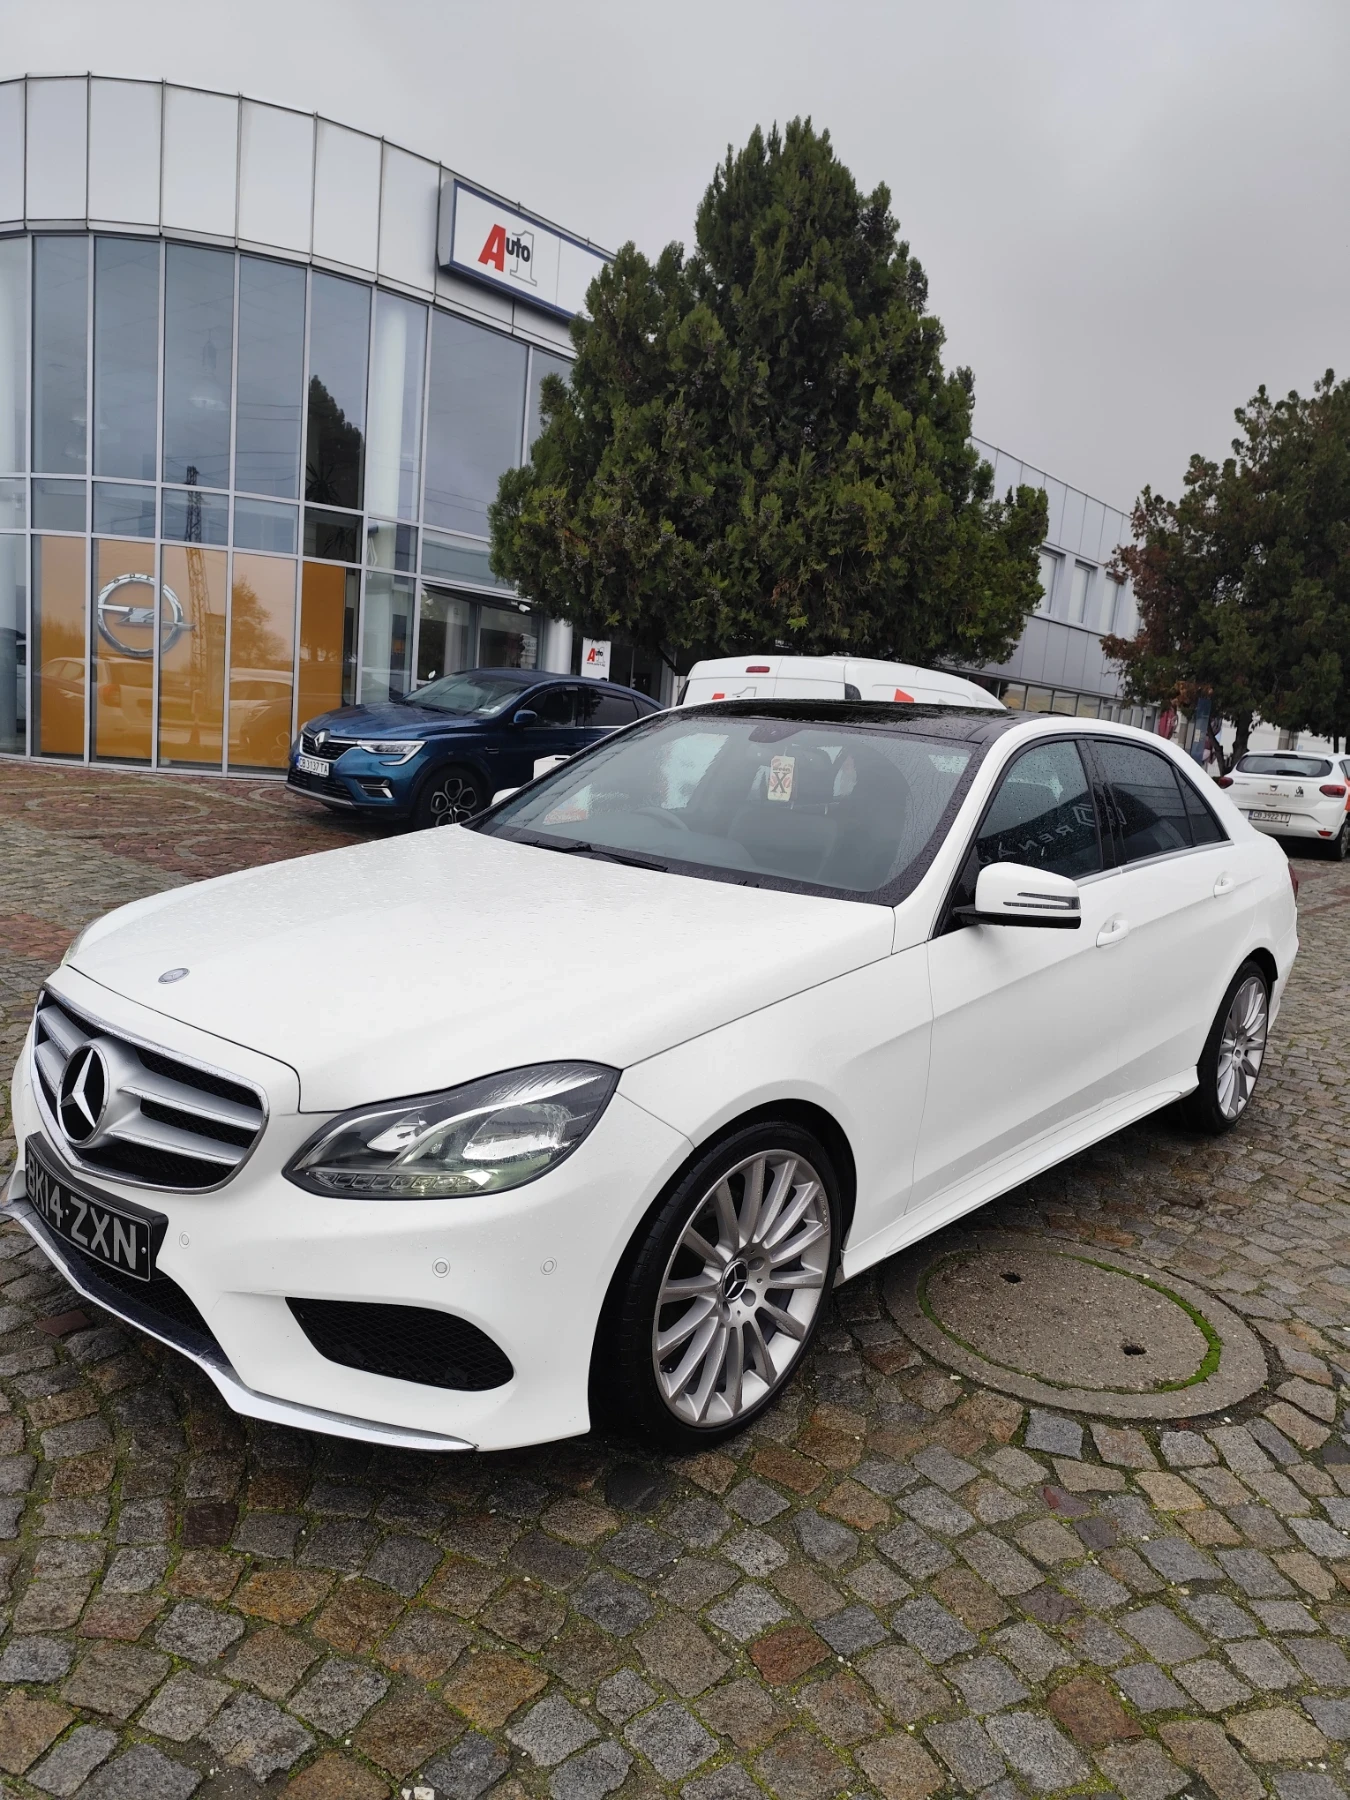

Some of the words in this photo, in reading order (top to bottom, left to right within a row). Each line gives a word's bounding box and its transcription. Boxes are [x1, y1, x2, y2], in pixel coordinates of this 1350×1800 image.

[478, 223, 531, 273] Auto
[1262, 812, 1279, 820] 3922
[1280, 813, 1289, 821] TT
[27, 1152, 64, 1228] BK14
[70, 1195, 137, 1270] ZXN
